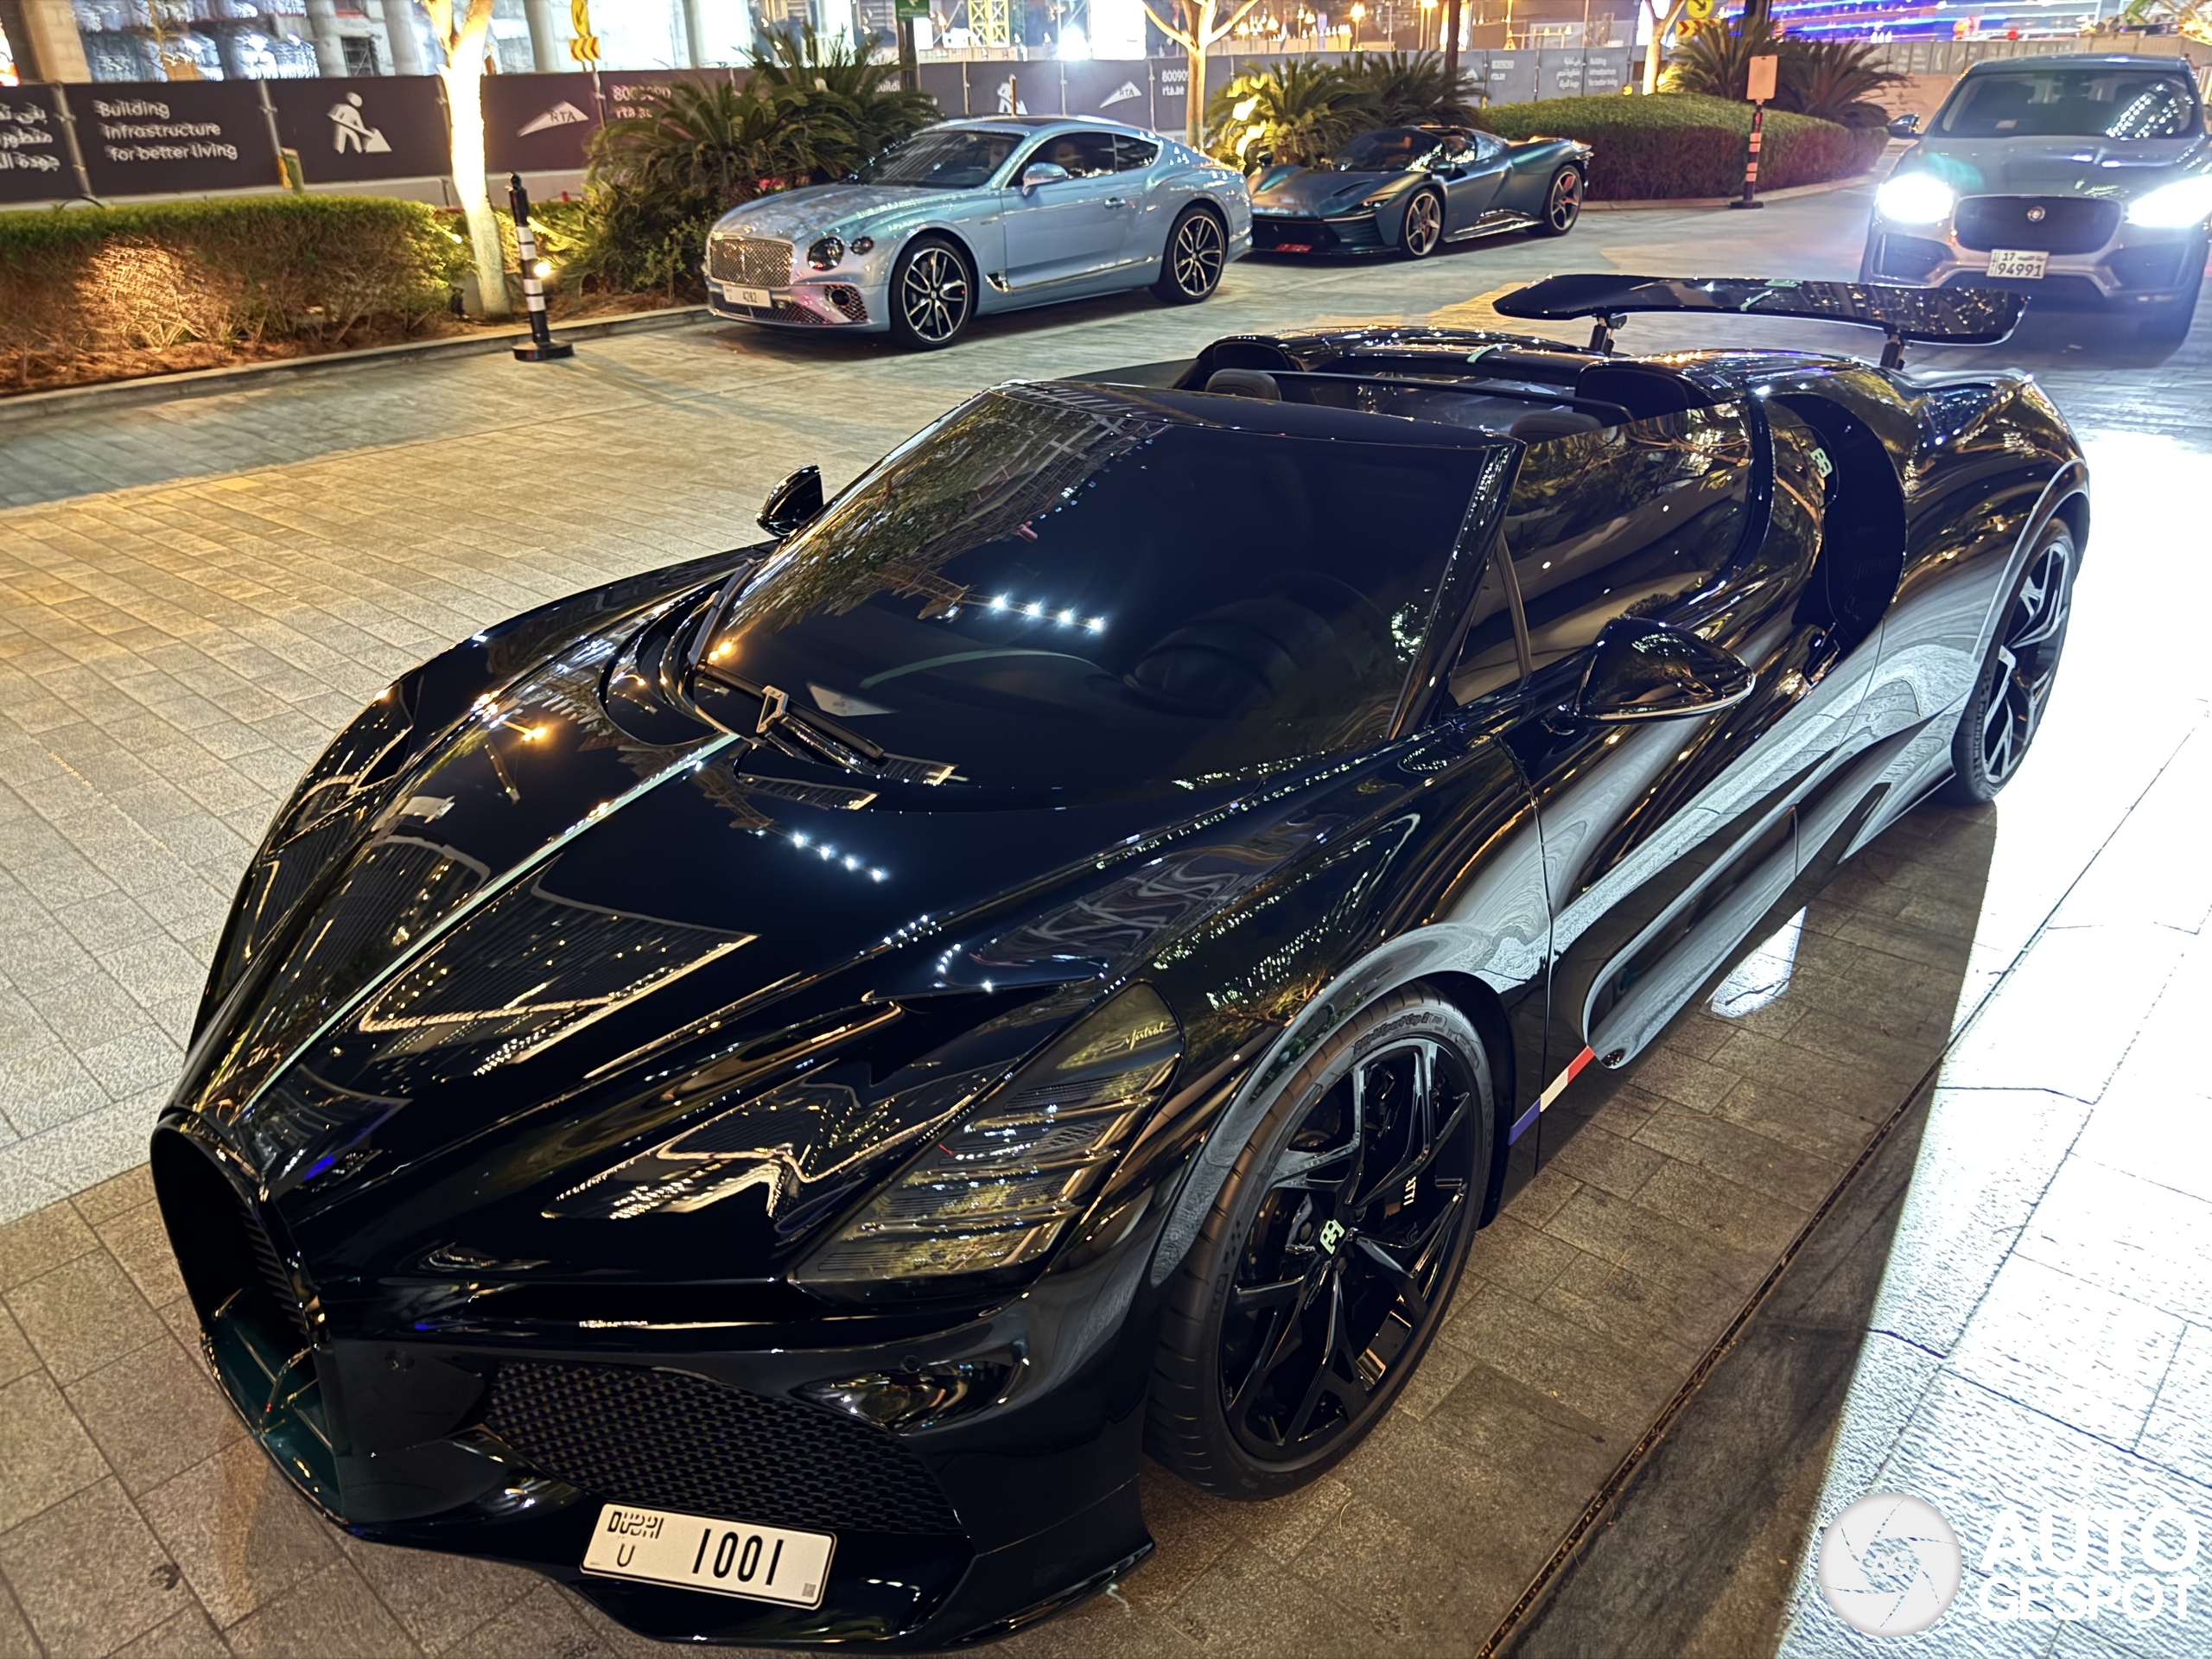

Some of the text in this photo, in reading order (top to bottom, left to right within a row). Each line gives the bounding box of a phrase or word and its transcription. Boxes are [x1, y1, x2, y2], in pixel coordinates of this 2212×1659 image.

[875, 79, 900, 92] uildi
[92, 99, 170, 119] Building
[550, 111, 577, 123] RTA
[98, 123, 221, 139] infrastructure
[105, 141, 238, 162] for better living
[2002, 252, 2016, 261] 17
[1998, 263, 2042, 276] 94991
[616, 1542, 636, 1568] U
[691, 1528, 785, 1586] 1001
